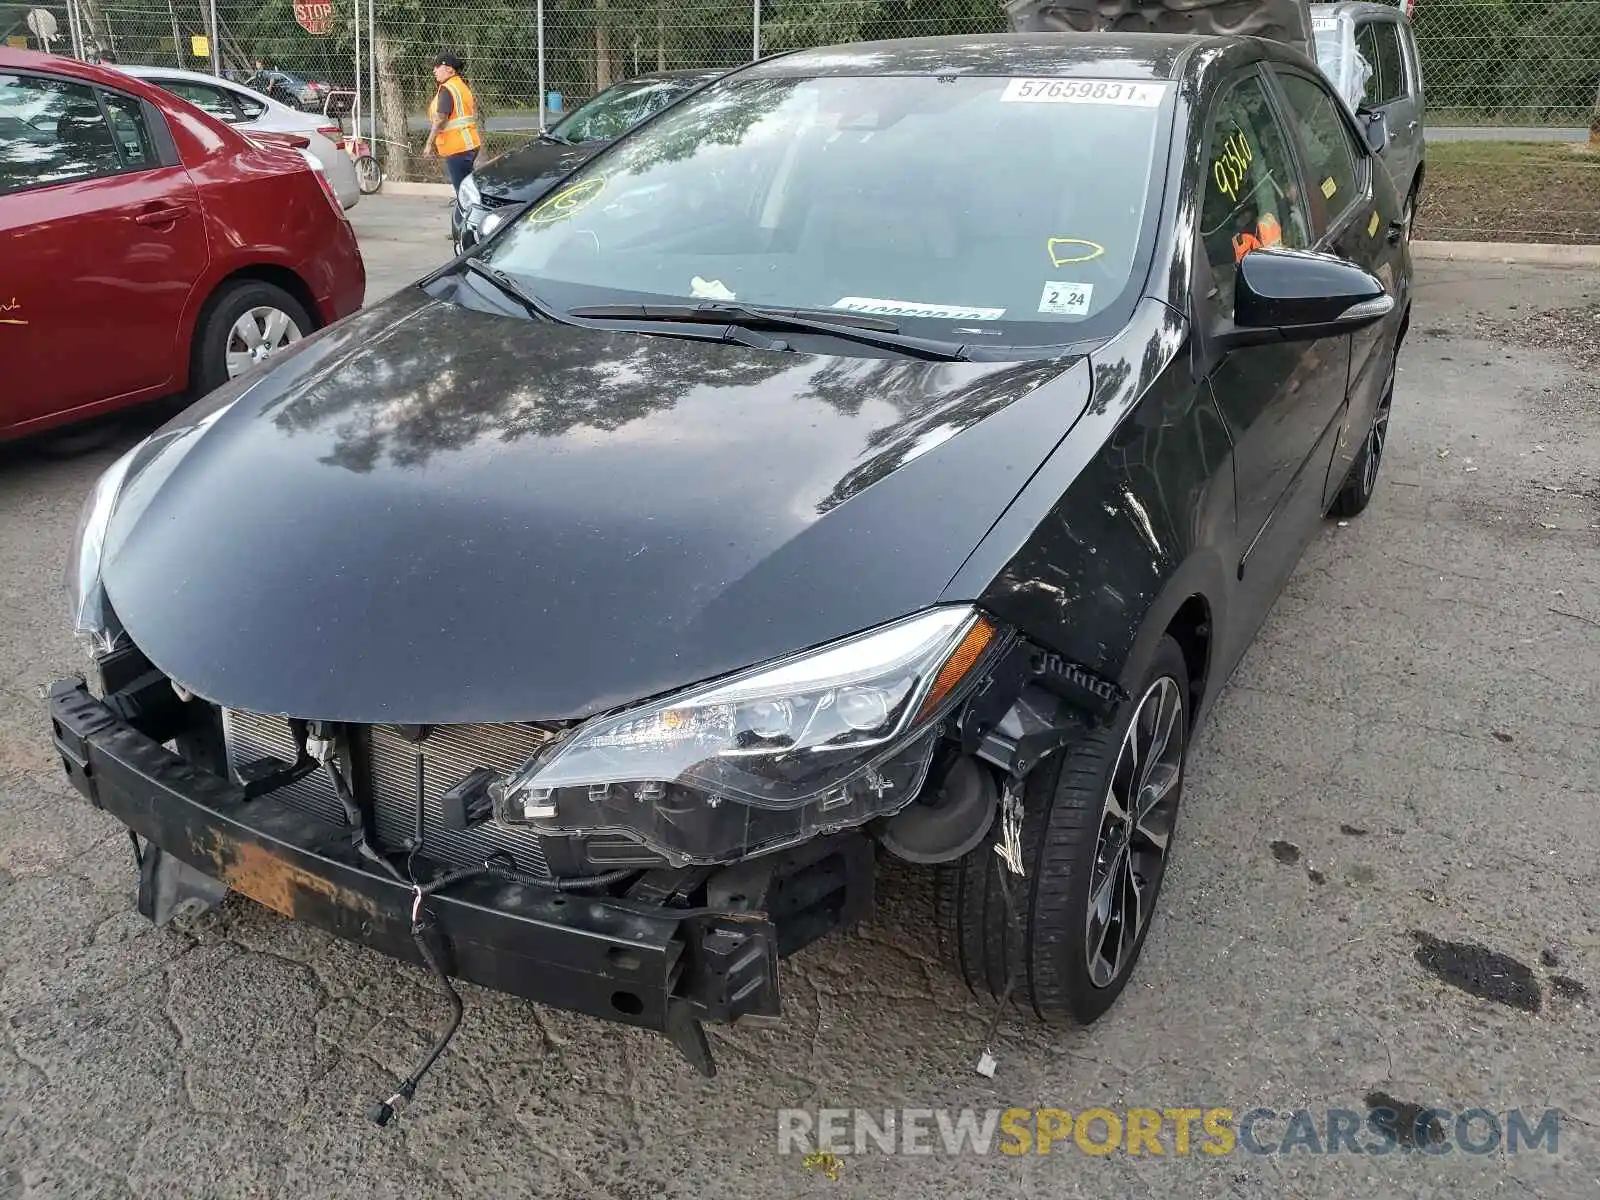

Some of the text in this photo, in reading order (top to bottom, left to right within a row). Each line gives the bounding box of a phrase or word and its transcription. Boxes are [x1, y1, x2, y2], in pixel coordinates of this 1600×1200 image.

[297, 3, 332, 20] STOP
[1047, 291, 1085, 306] 2 24
